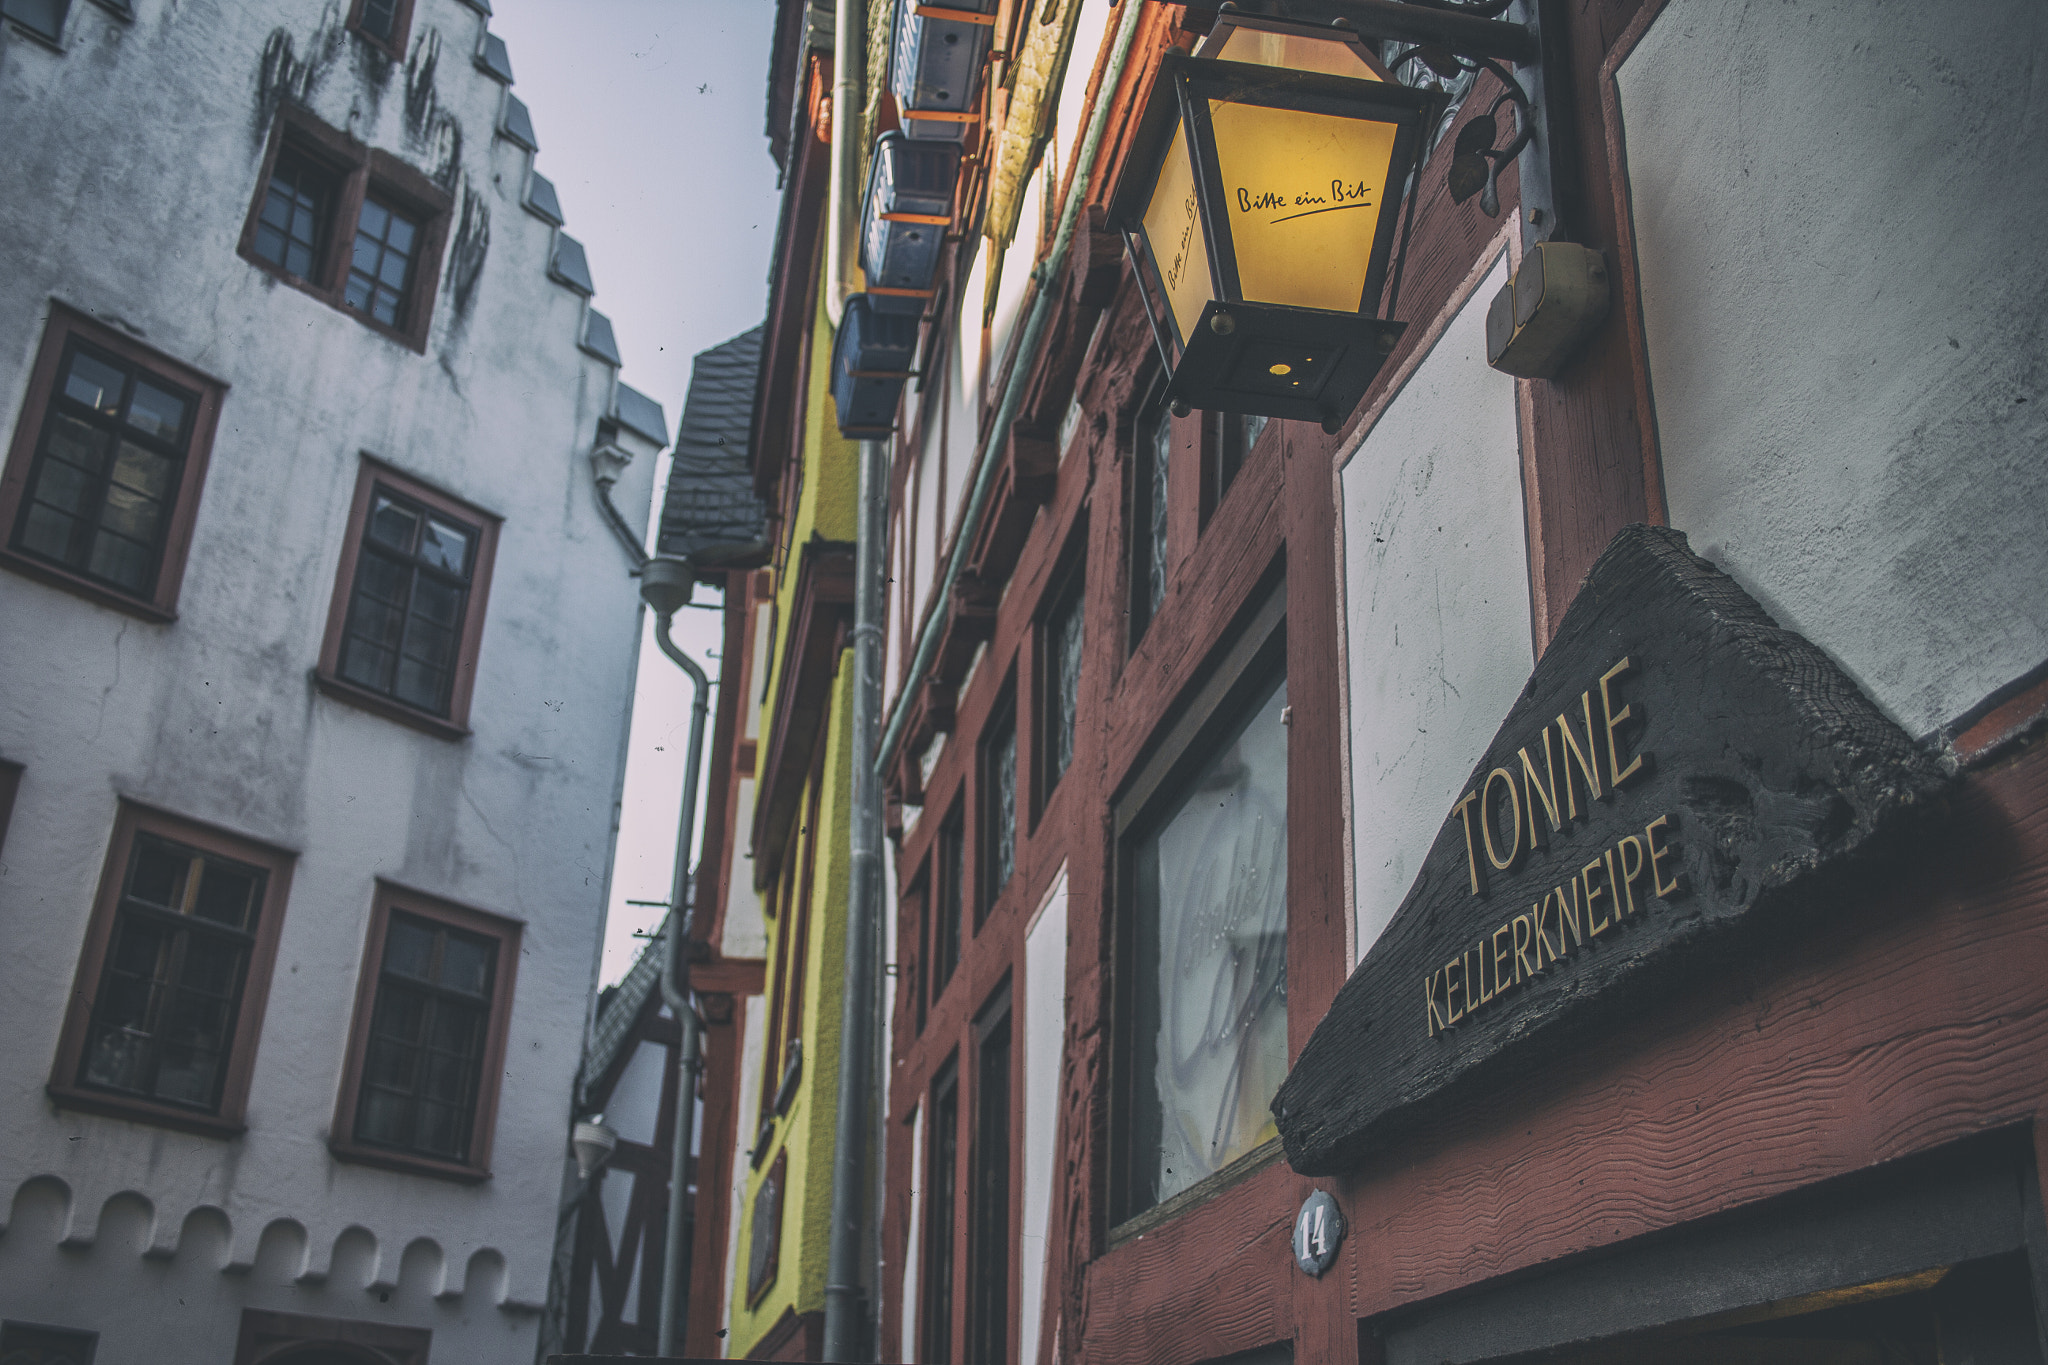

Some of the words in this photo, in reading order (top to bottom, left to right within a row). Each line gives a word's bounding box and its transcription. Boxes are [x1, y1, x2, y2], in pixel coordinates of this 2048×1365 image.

[1237, 187, 1287, 213] Bitte
[1294, 191, 1327, 206] ein
[1331, 179, 1372, 203] Bit
[1167, 252, 1183, 291] Bitte
[1452, 655, 1643, 897] TONNE
[1424, 814, 1678, 1038] KELLERKNEIPE
[1300, 1204, 1328, 1261] 14
